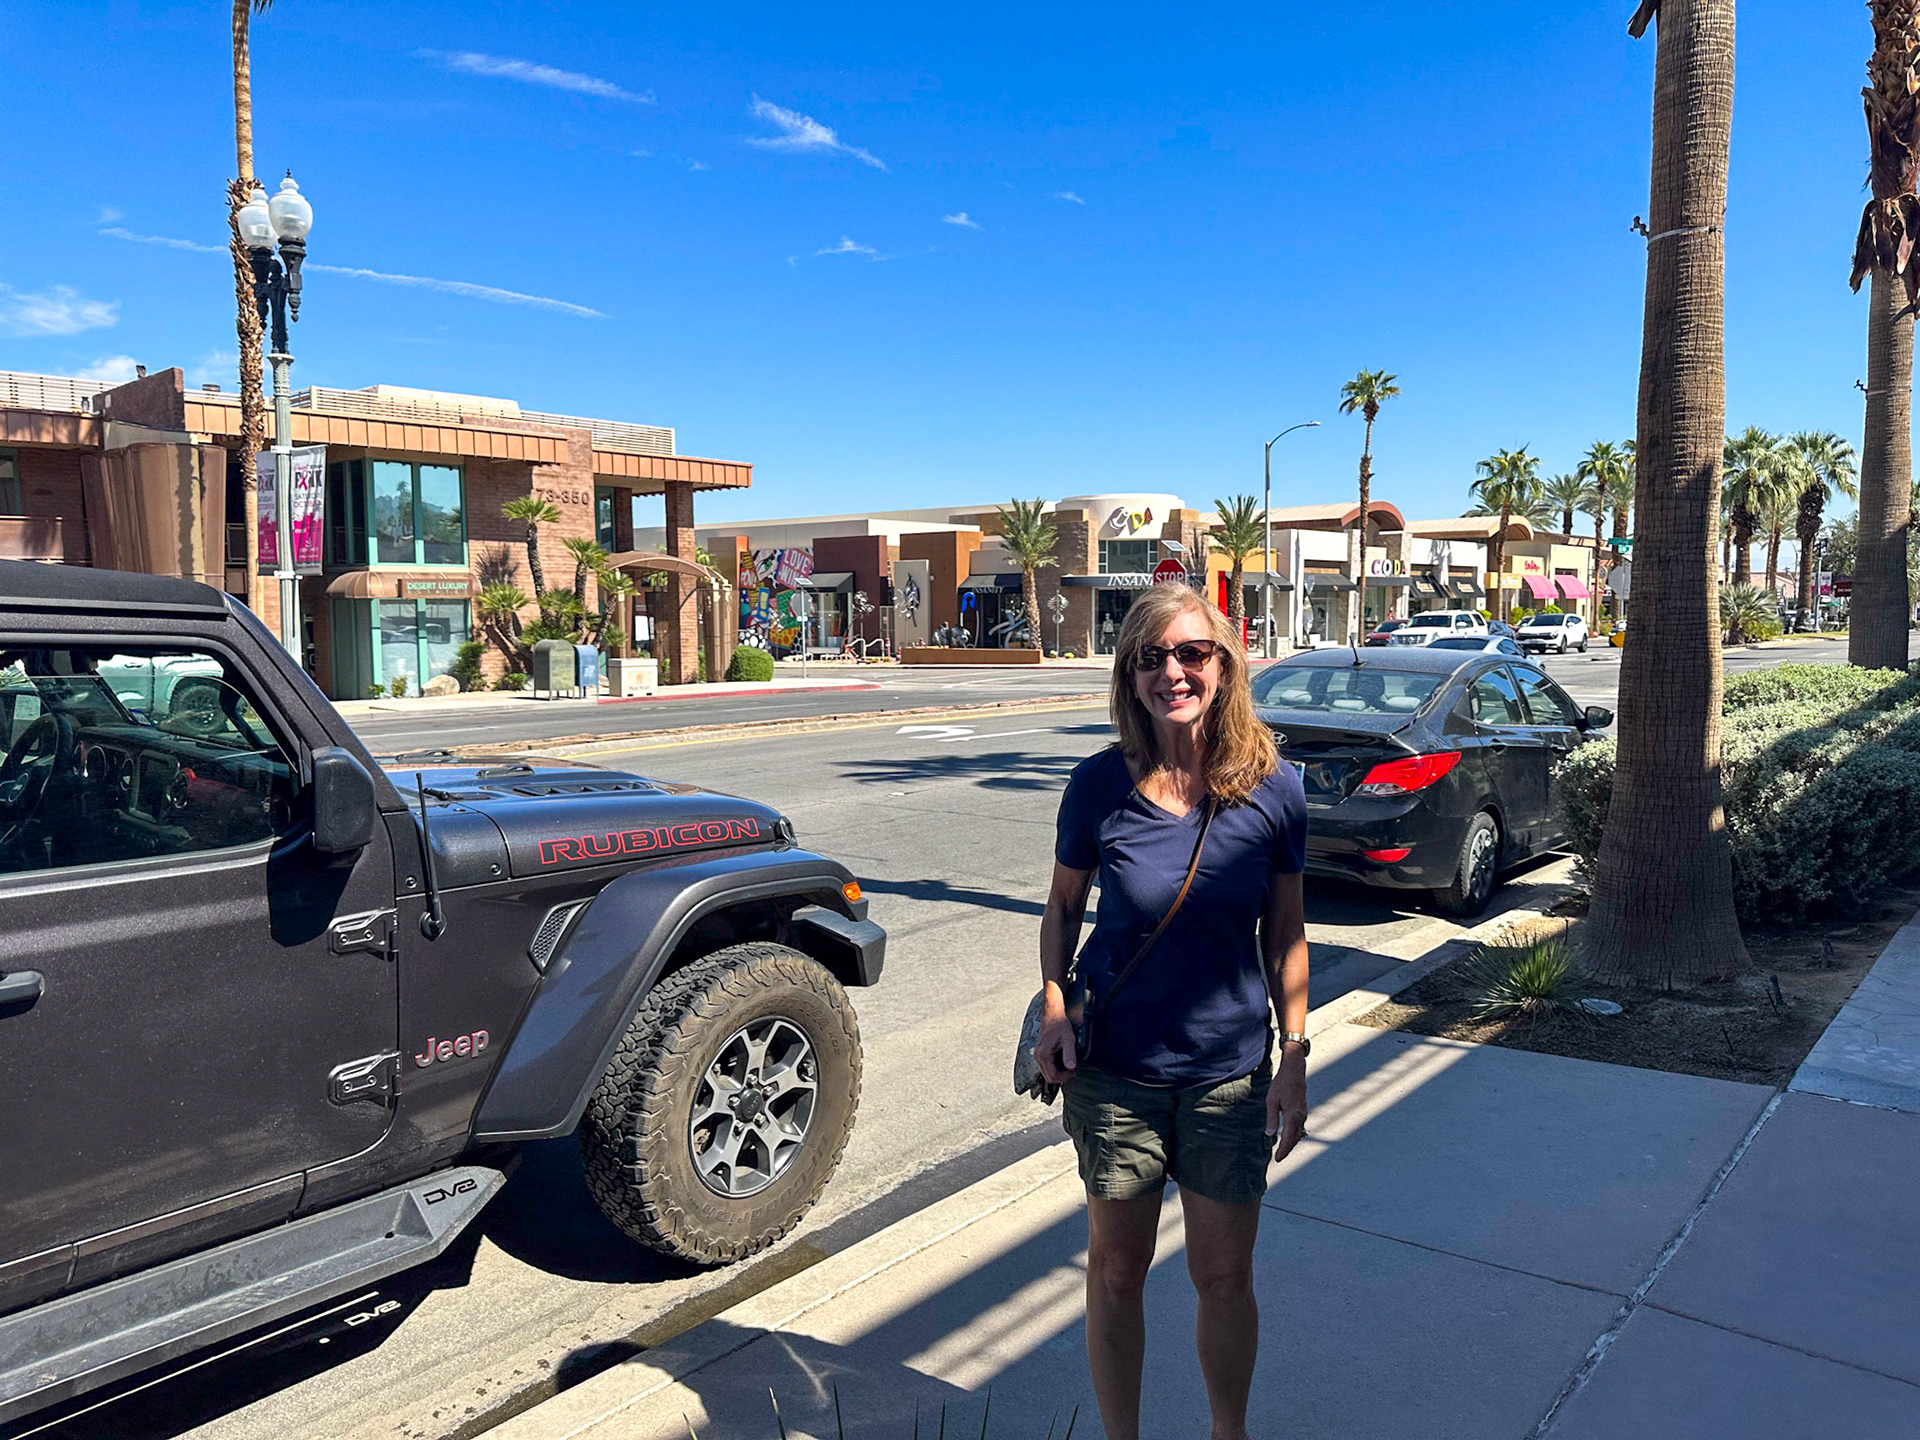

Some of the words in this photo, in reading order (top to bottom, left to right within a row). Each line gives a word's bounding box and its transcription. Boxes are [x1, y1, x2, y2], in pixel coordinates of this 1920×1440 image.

[536, 488, 589, 505] 73-350
[784, 549, 811, 574] LOVE
[1155, 571, 1185, 583] STOP
[407, 582, 437, 590] DESERT
[438, 582, 468, 590] LUXURY
[972, 586, 1004, 594] INSANITY
[538, 818, 760, 865] RUBICON
[415, 1028, 490, 1069] Jeep
